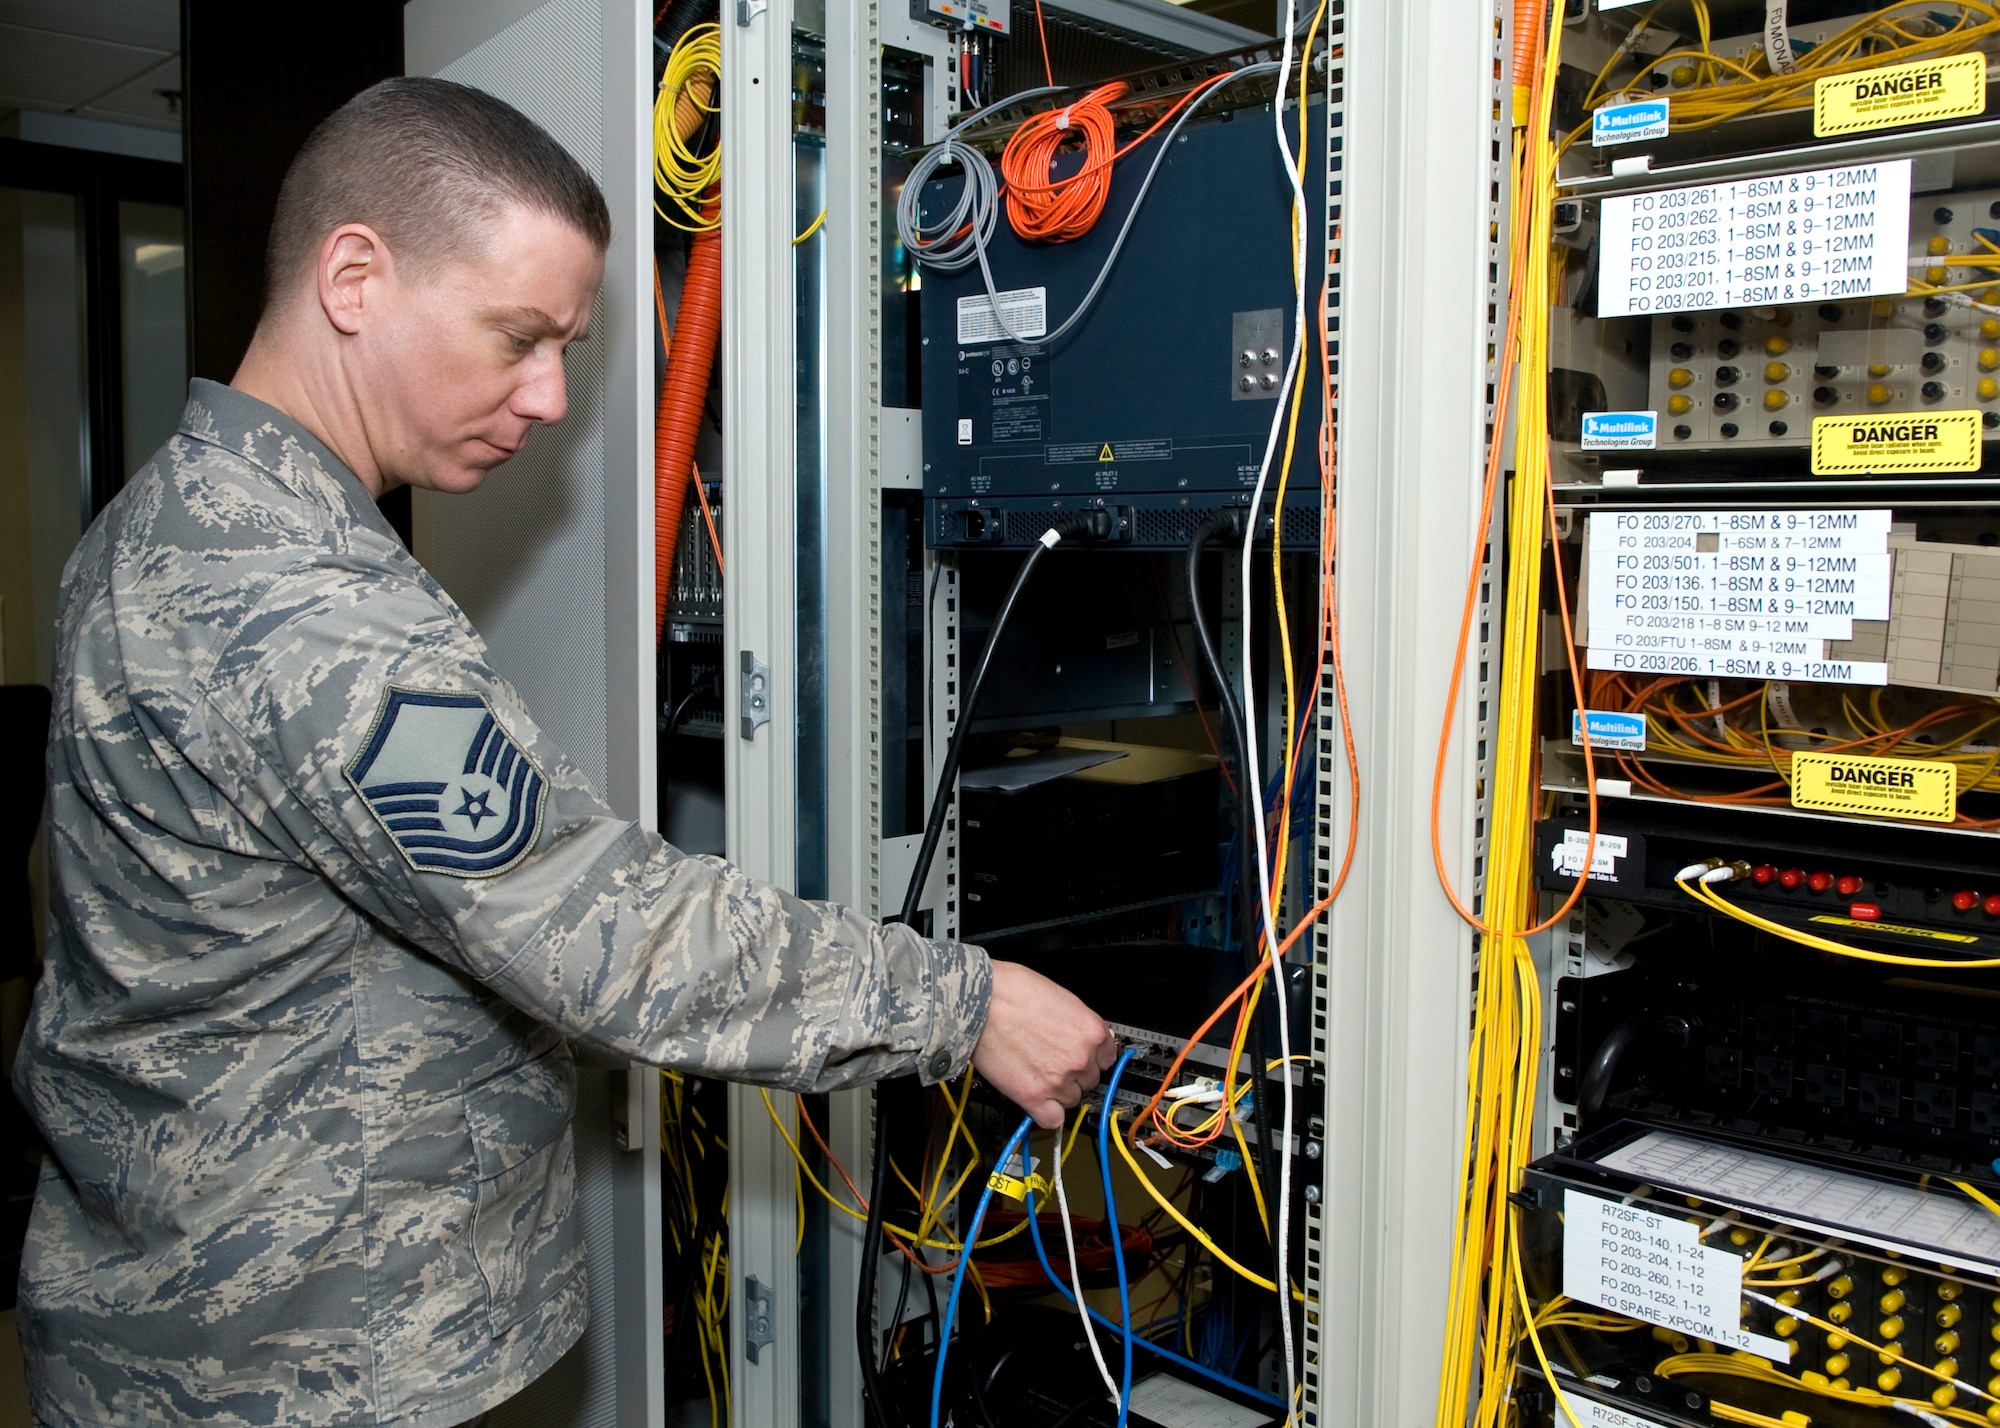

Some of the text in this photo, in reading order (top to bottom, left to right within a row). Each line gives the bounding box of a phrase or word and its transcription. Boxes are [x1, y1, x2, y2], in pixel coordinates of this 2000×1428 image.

[1771, 7, 1783, 25] FD
[1856, 72, 1942, 100] DANGER
[1890, 93, 1914, 102] radiation
[1890, 100, 1915, 109] exposure
[1611, 110, 1661, 127] Multilink
[1595, 128, 1665, 142] Technologies Group
[1633, 196, 1654, 212] FO
[1730, 180, 1783, 200] 1-8SM
[1789, 178, 1799, 193] &
[1806, 168, 1877, 191] 9-12MM
[1632, 216, 1654, 232] FO
[1729, 201, 1781, 220] 1-8SM
[1788, 199, 1798, 214] &
[1804, 190, 1875, 212] 9-12MM
[1632, 236, 1653, 252] FO
[1728, 222, 1780, 241] 1-8SM
[1786, 220, 1797, 236] &
[1804, 212, 1874, 233] 9-12MM
[1631, 256, 1652, 271] FO
[1728, 244, 1780, 262] 1-8SM
[1786, 242, 1796, 257] &
[1803, 233, 1873, 255] 9-12MM
[1630, 277, 1651, 291] FO
[1726, 264, 1779, 283] 1-8SM
[1785, 263, 1795, 278] &
[1802, 256, 1872, 276] 9-12MM
[1629, 297, 1650, 312] FO
[1726, 286, 1778, 304] 1-8SM
[1784, 285, 1794, 299] &
[1800, 277, 1871, 298] 9-12MM
[1600, 422, 1649, 433] Multilink
[1853, 425, 1938, 443] DANGER
[1584, 438, 1652, 448] Technologies Group
[1618, 516, 1639, 529] FO
[1713, 515, 1765, 530] 1-8SM
[1770, 515, 1781, 529] &
[1787, 514, 1857, 529] 9-12MM
[1620, 536, 1637, 547] FO
[1724, 537, 1766, 549] 1-6SM
[1771, 537, 1780, 549] &
[1785, 537, 1841, 548] 7-12MM
[1618, 555, 1638, 569] FO
[1712, 556, 1764, 571] 1-8SM
[1770, 556, 1780, 571] &
[1787, 557, 1856, 572] 9-12MM
[1616, 575, 1638, 589] FO
[1711, 576, 1763, 591] 1-8SM
[1768, 577, 1779, 592] &
[1785, 578, 1855, 594] 9-12MM
[1616, 594, 1637, 609] FO
[1710, 598, 1762, 612] 1-8SM
[1768, 598, 1778, 613] &
[1784, 599, 1854, 615] 9-12MM
[1627, 615, 1808, 633] FO 203/218 1-8 SM 9-12 MM
[1616, 634, 1806, 654] FO 203/FTU 1-8SM & 9-12MM
[1614, 654, 1635, 668] FO
[1709, 658, 1760, 674] 1-8SM
[1766, 661, 1776, 675] &
[1782, 662, 1851, 679] 9-12MM
[1590, 721, 1638, 734] Multilink
[1574, 735, 1643, 749] Tenologies Group
[1831, 767, 1914, 788] DANGER
[1863, 791, 1888, 799] exposure
[1602, 1204, 1662, 1232] R72SF-ST
[1602, 1222, 1704, 1260] FO 203-140, 1-24
[1602, 1239, 1704, 1278] FO 203-204, 1-12
[1602, 1257, 1703, 1296] FO 203-260, 1-12
[1602, 1276, 1710, 1317] FO 203-1252, 1-12
[1601, 1294, 1749, 1348] FO SPARE-XPCOM, 1-12
[1593, 1406, 1652, 1428] R72SF-S
